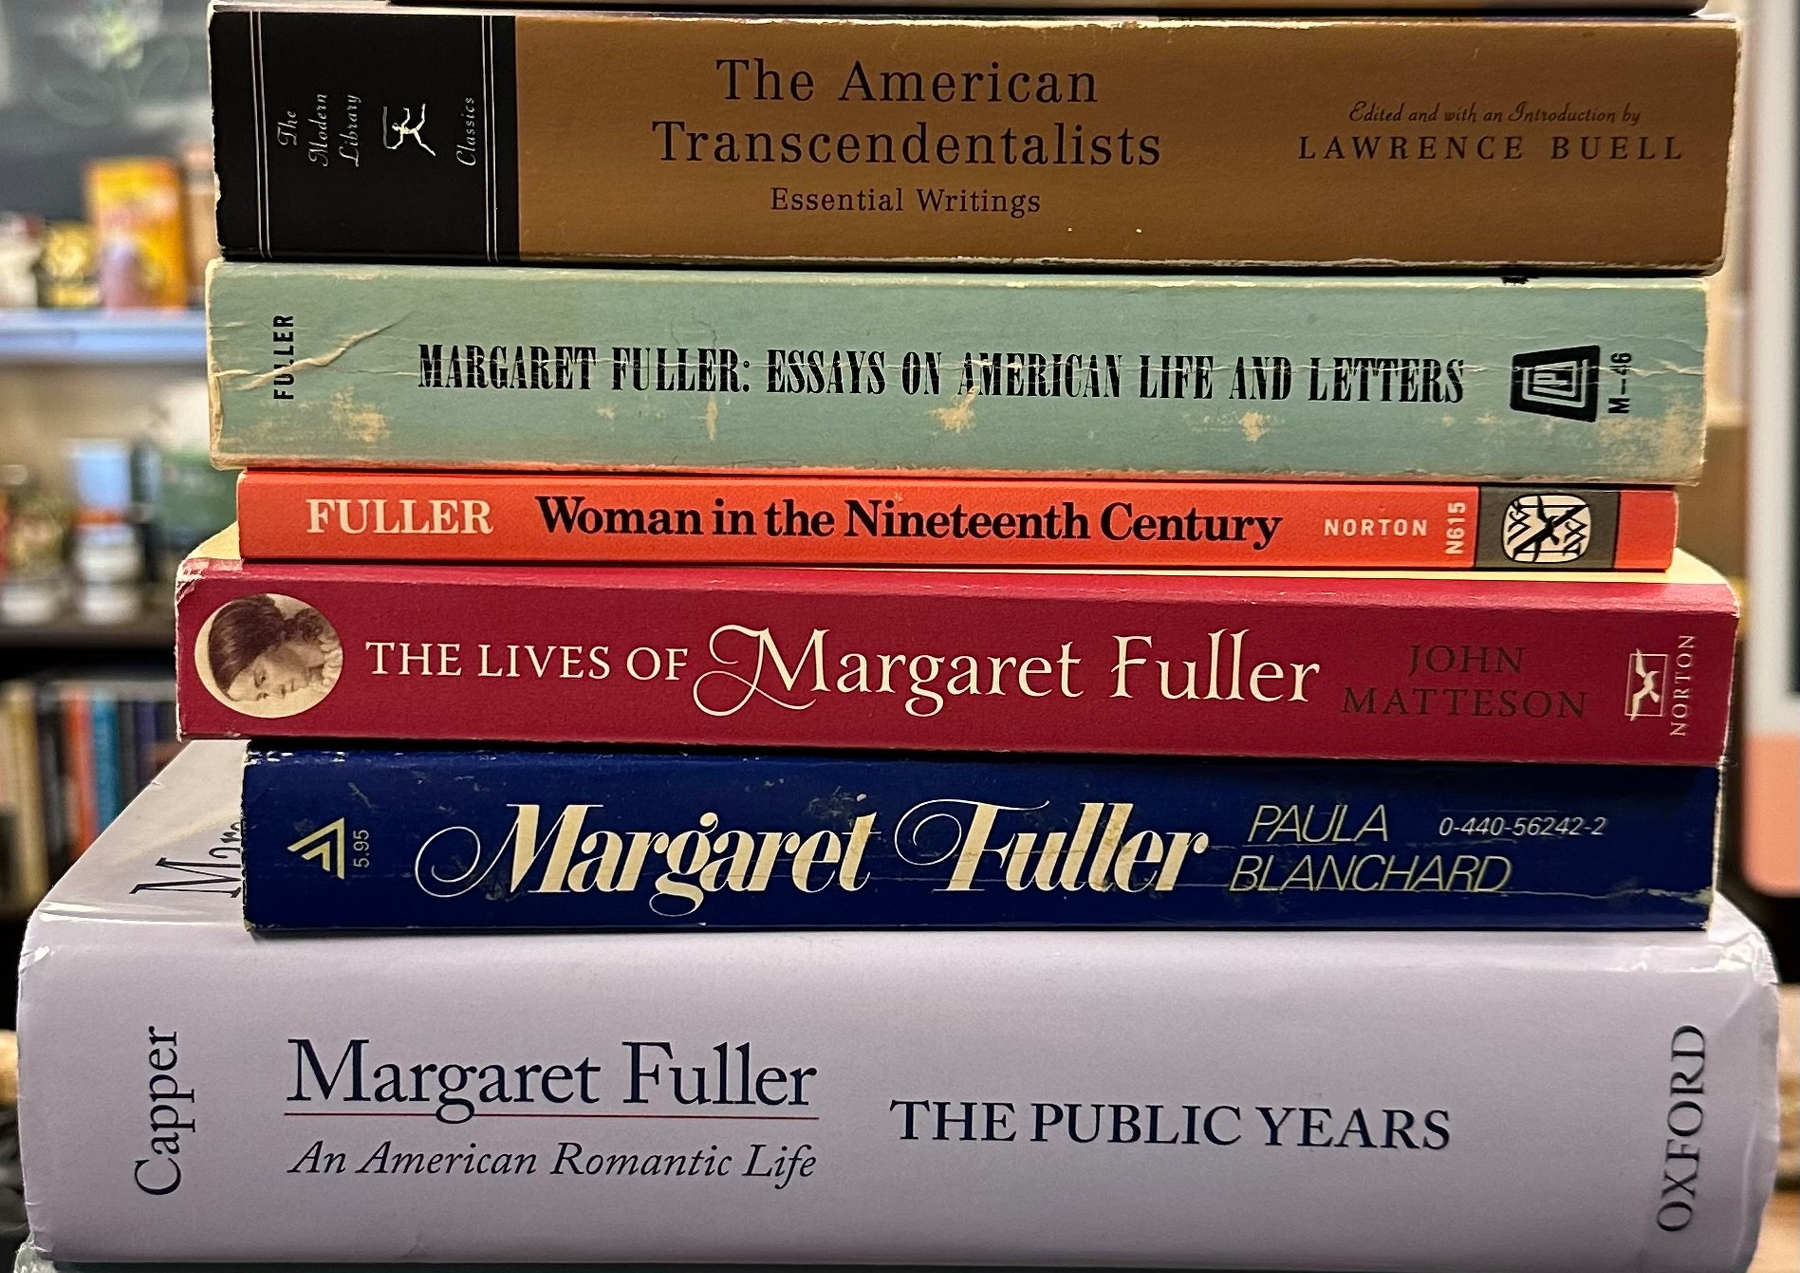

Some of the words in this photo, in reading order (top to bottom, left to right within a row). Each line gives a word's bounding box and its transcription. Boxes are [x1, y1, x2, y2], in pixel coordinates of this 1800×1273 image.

[717, 58, 813, 101] The
[838, 61, 1097, 103] American
[277, 111, 297, 145] The
[308, 94, 328, 166] Modern
[339, 95, 361, 167] Library
[456, 98, 476, 165] Classics
[1349, 101, 1402, 121] Edited
[1409, 103, 1440, 122] and
[1445, 102, 1476, 123] with
[1483, 111, 1503, 124] an
[1508, 101, 1615, 123] Introduction
[1619, 102, 1641, 127] by
[653, 121, 1159, 165] Transcendentalists
[1299, 136, 1522, 159] LAWRENCE
[1551, 137, 1681, 159] BUELL
[771, 187, 903, 211] Essential
[916, 188, 1041, 217] Writings
[272, 316, 295, 399] FULLER
[418, 344, 597, 389] MARGARET
[612, 347, 749, 392] FULLER:
[767, 350, 885, 394] ESSAYS
[902, 352, 941, 395] ON
[958, 352, 1119, 397] AMERICAN
[1140, 355, 1213, 399] LIFE
[1229, 357, 1291, 400] AND
[1308, 358, 1465, 403] LETTERS
[306, 499, 493, 533] FULLER
[536, 496, 704, 535] Woman
[712, 498, 757, 535] in
[765, 499, 834, 536] the
[846, 500, 1091, 539] Nineteenth
[1101, 503, 1282, 550] Century
[1325, 518, 1426, 536] NORTON
[1446, 503, 1466, 554] N615
[1670, 636, 1695, 736] NORTON
[1247, 804, 1387, 843] PAULA
[1439, 817, 1606, 836] 0-440-56242-2
[415, 804, 875, 916] Margaret
[895, 799, 1208, 892] Fuller
[1229, 854, 1513, 893] BLANCHARD
[285, 1039, 602, 1124] Margaret
[622, 1042, 817, 1105] Fuller
[134, 1026, 195, 1195] Capper
[890, 1100, 1016, 1141] THE
[1030, 1103, 1241, 1145] PUBLIC
[1256, 1107, 1449, 1150] YEARS
[1656, 1025, 1705, 1234] OXFORD
[287, 1141, 345, 1173] An
[355, 1142, 536, 1174] American
[550, 1143, 732, 1176] Romantic
[742, 1144, 816, 1189] Life
